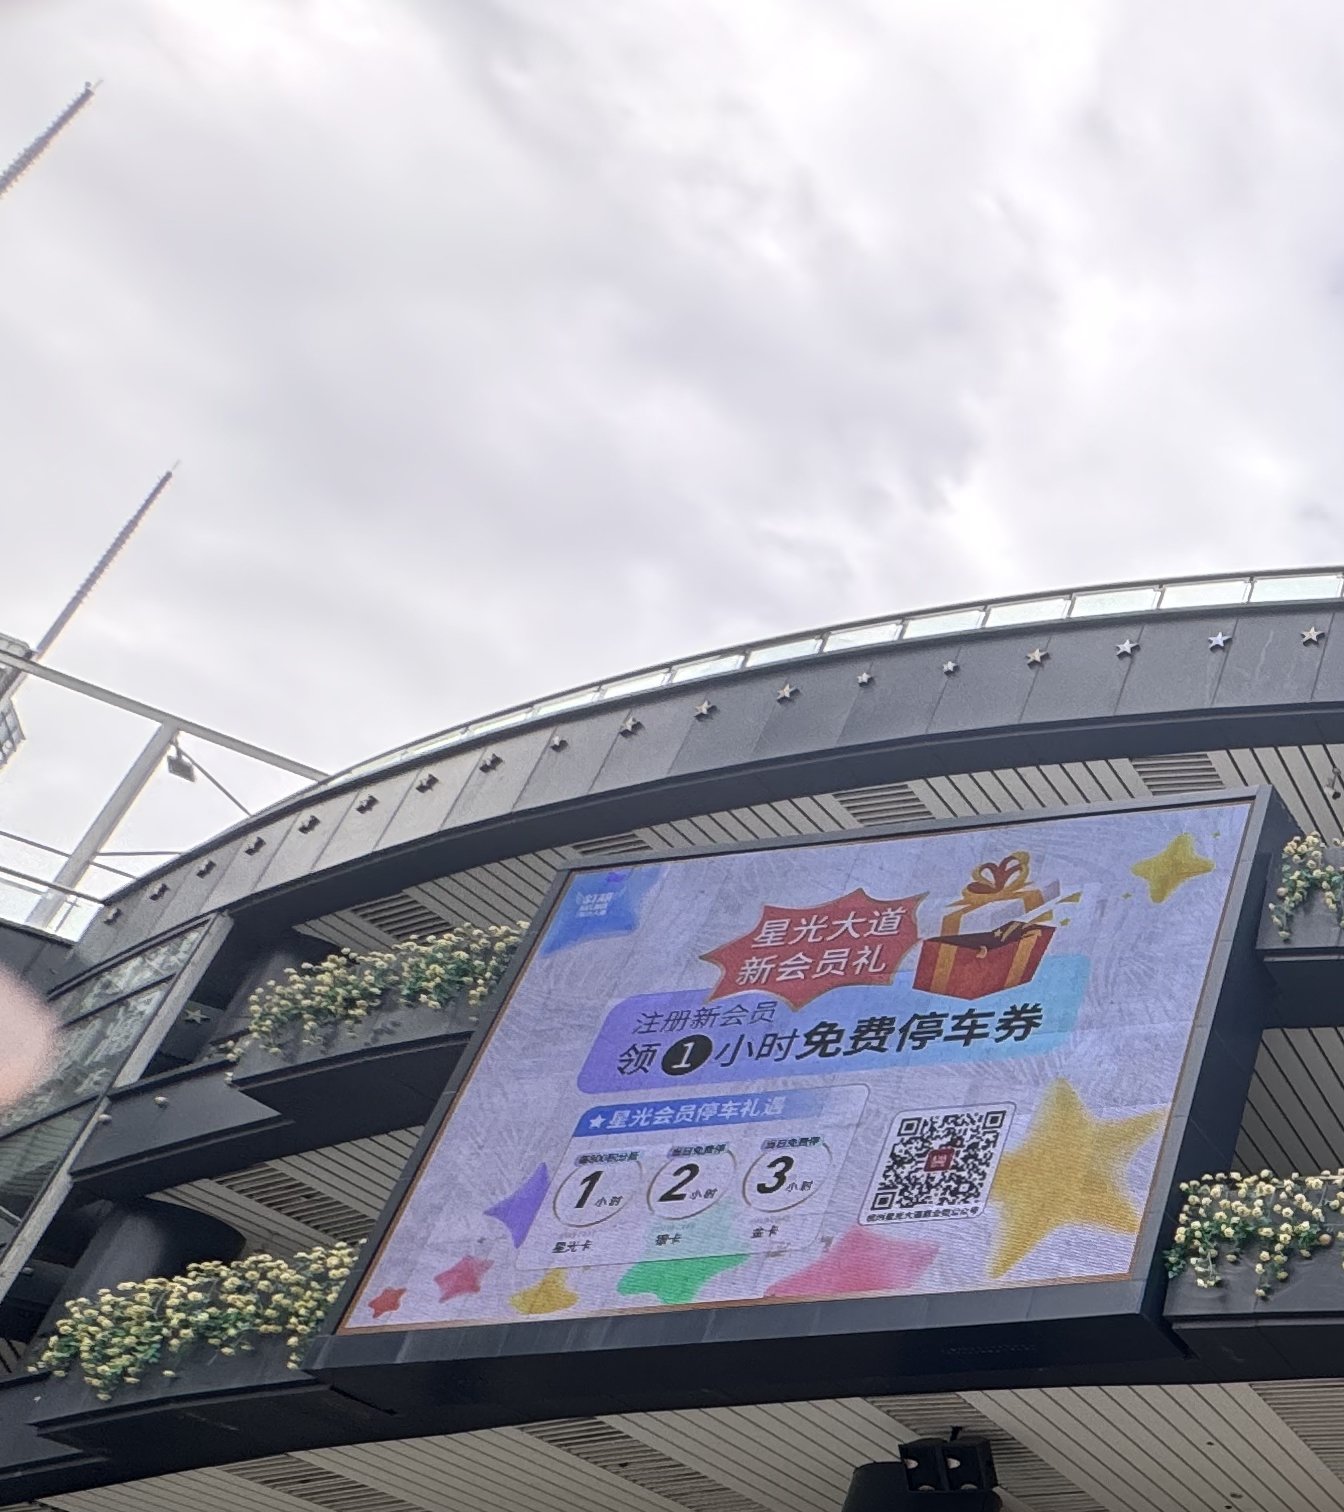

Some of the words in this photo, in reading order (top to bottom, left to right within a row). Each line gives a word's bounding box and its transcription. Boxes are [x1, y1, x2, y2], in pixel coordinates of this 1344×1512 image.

[752, 907, 906, 949] 星光大道
[736, 944, 889, 987] 新会员礼
[631, 1000, 779, 1036] 注册新会员
[605, 1096, 787, 1130] 星光会员停车礼遇
